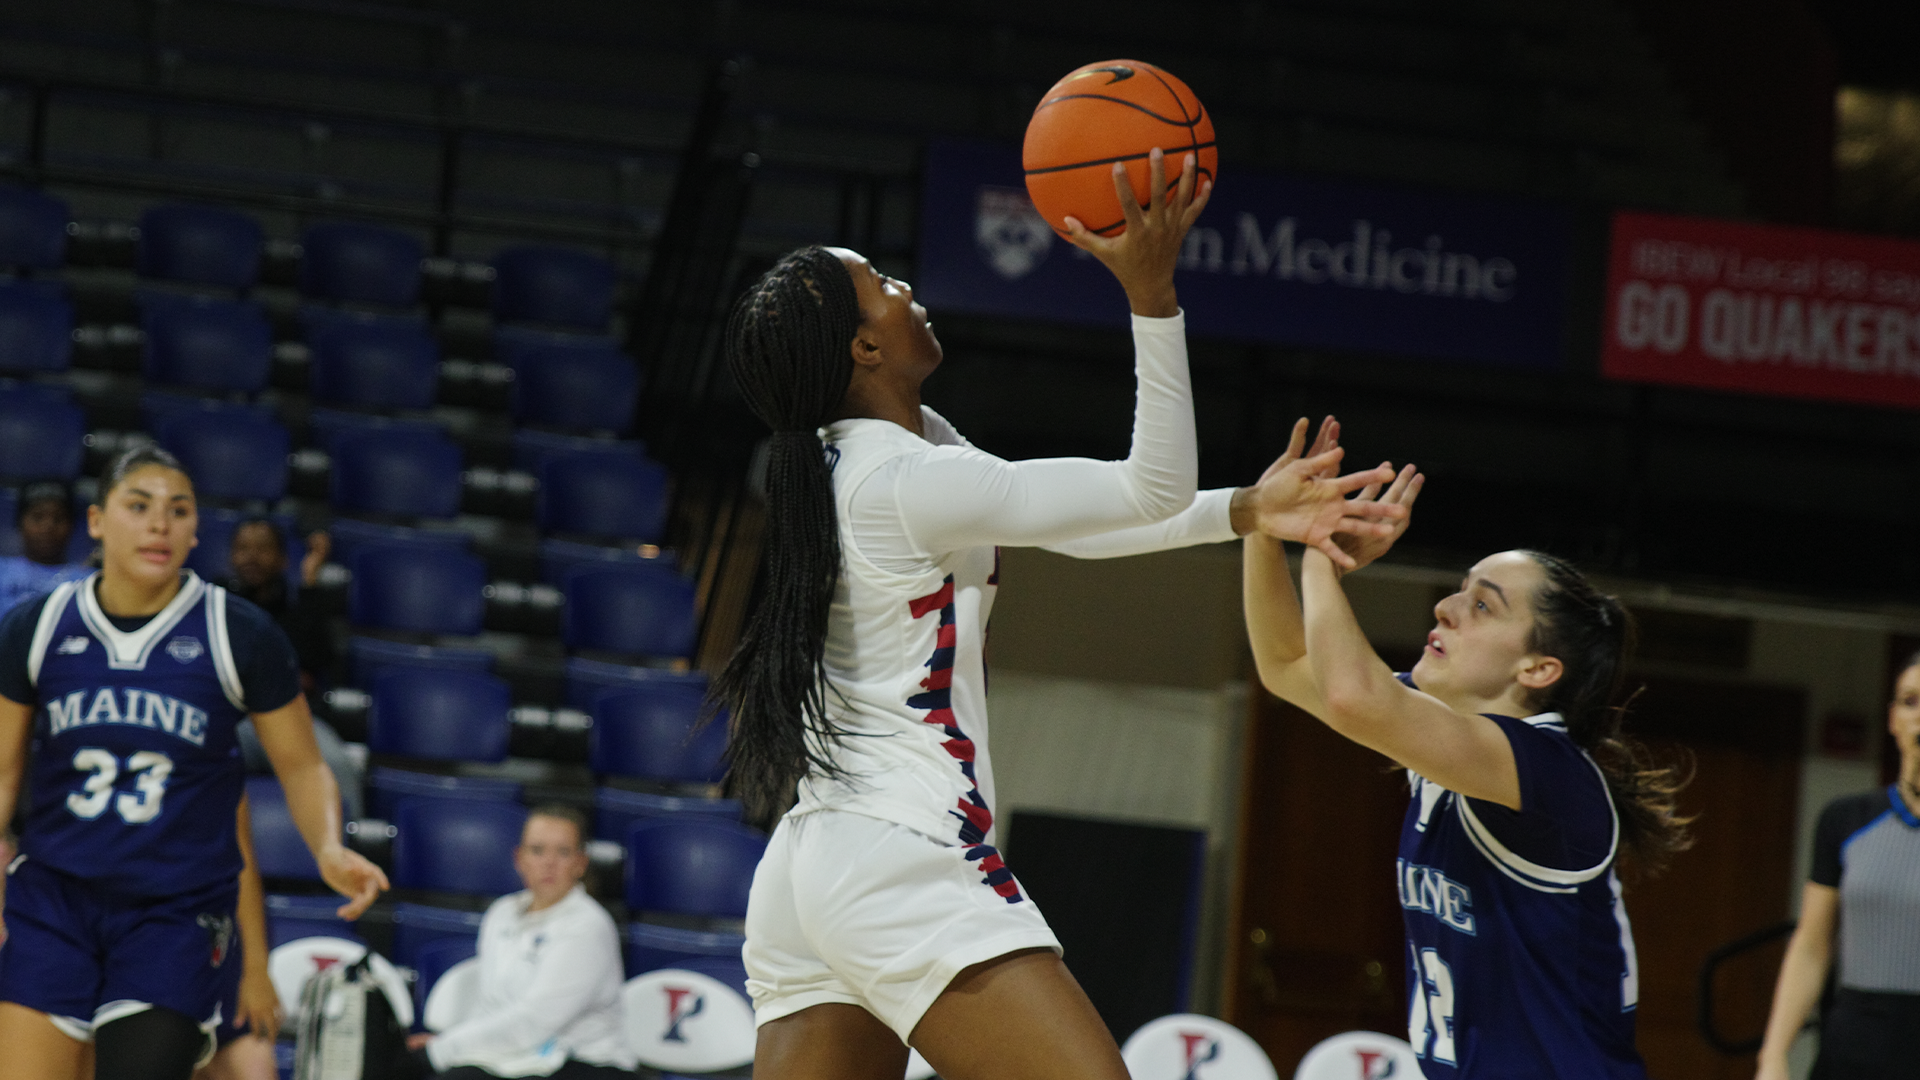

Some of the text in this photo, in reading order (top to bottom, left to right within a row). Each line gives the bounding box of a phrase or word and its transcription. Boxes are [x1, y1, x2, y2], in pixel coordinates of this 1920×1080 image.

[1230, 211, 1517, 302] Medicine
[1723, 247, 1818, 294] Local
[1618, 281, 1690, 354] GO
[45, 685, 209, 747] MAINE
[65, 746, 176, 826] 33
[1396, 857, 1477, 936] INE
[661, 985, 704, 1043] P
[1408, 941, 1458, 1068] 12
